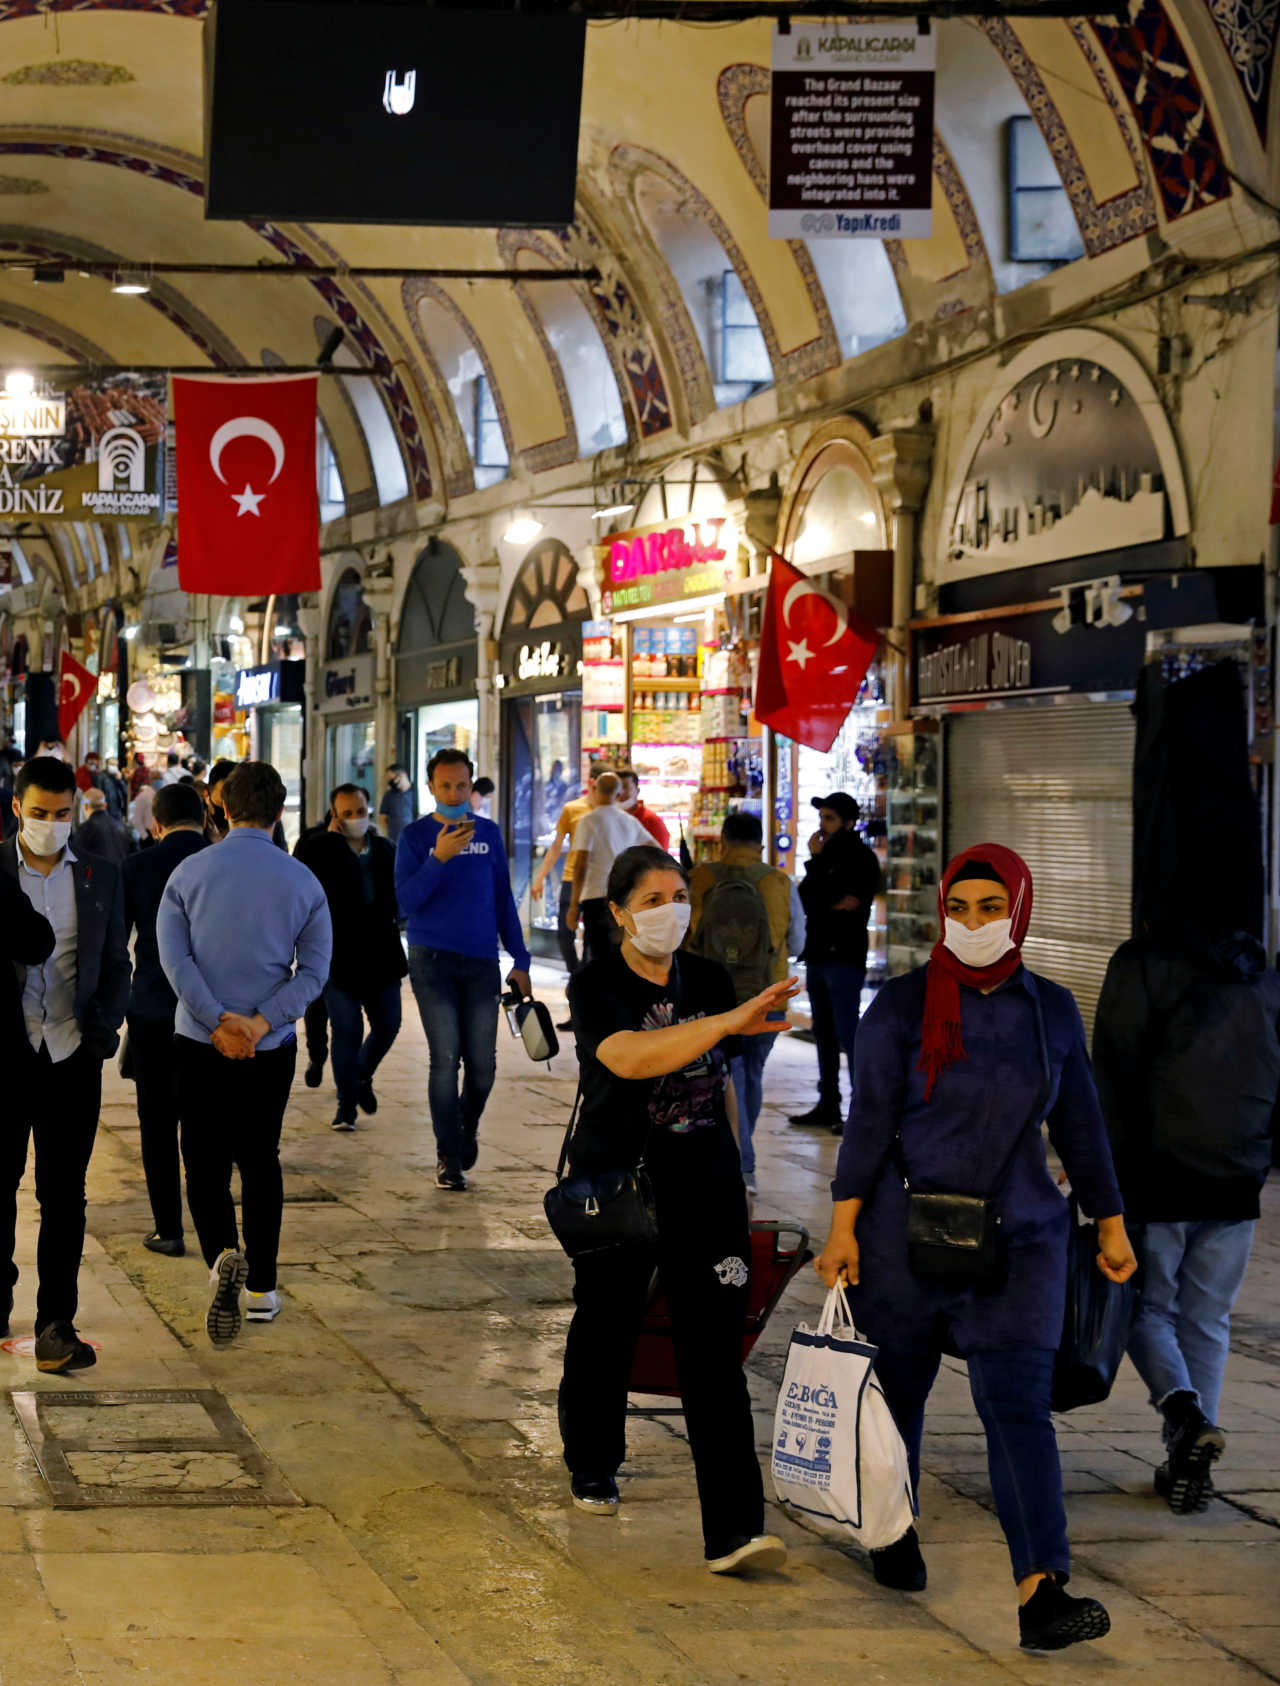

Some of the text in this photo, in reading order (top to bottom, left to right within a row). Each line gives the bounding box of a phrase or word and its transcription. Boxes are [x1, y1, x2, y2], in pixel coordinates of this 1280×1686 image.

[804, 78, 902, 91] The Grand Bazaar
[786, 95, 920, 110] reached its present size
[792, 110, 913, 125] after the surrounding
[790, 126, 914, 139] streets were provided
[792, 141, 912, 156] overhead cover using
[809, 156, 894, 169] canvas and the
[787, 172, 915, 187] neighboring hans were
[802, 188, 900, 203] integrated into it.
[836, 214, 901, 232] YapıKredi
